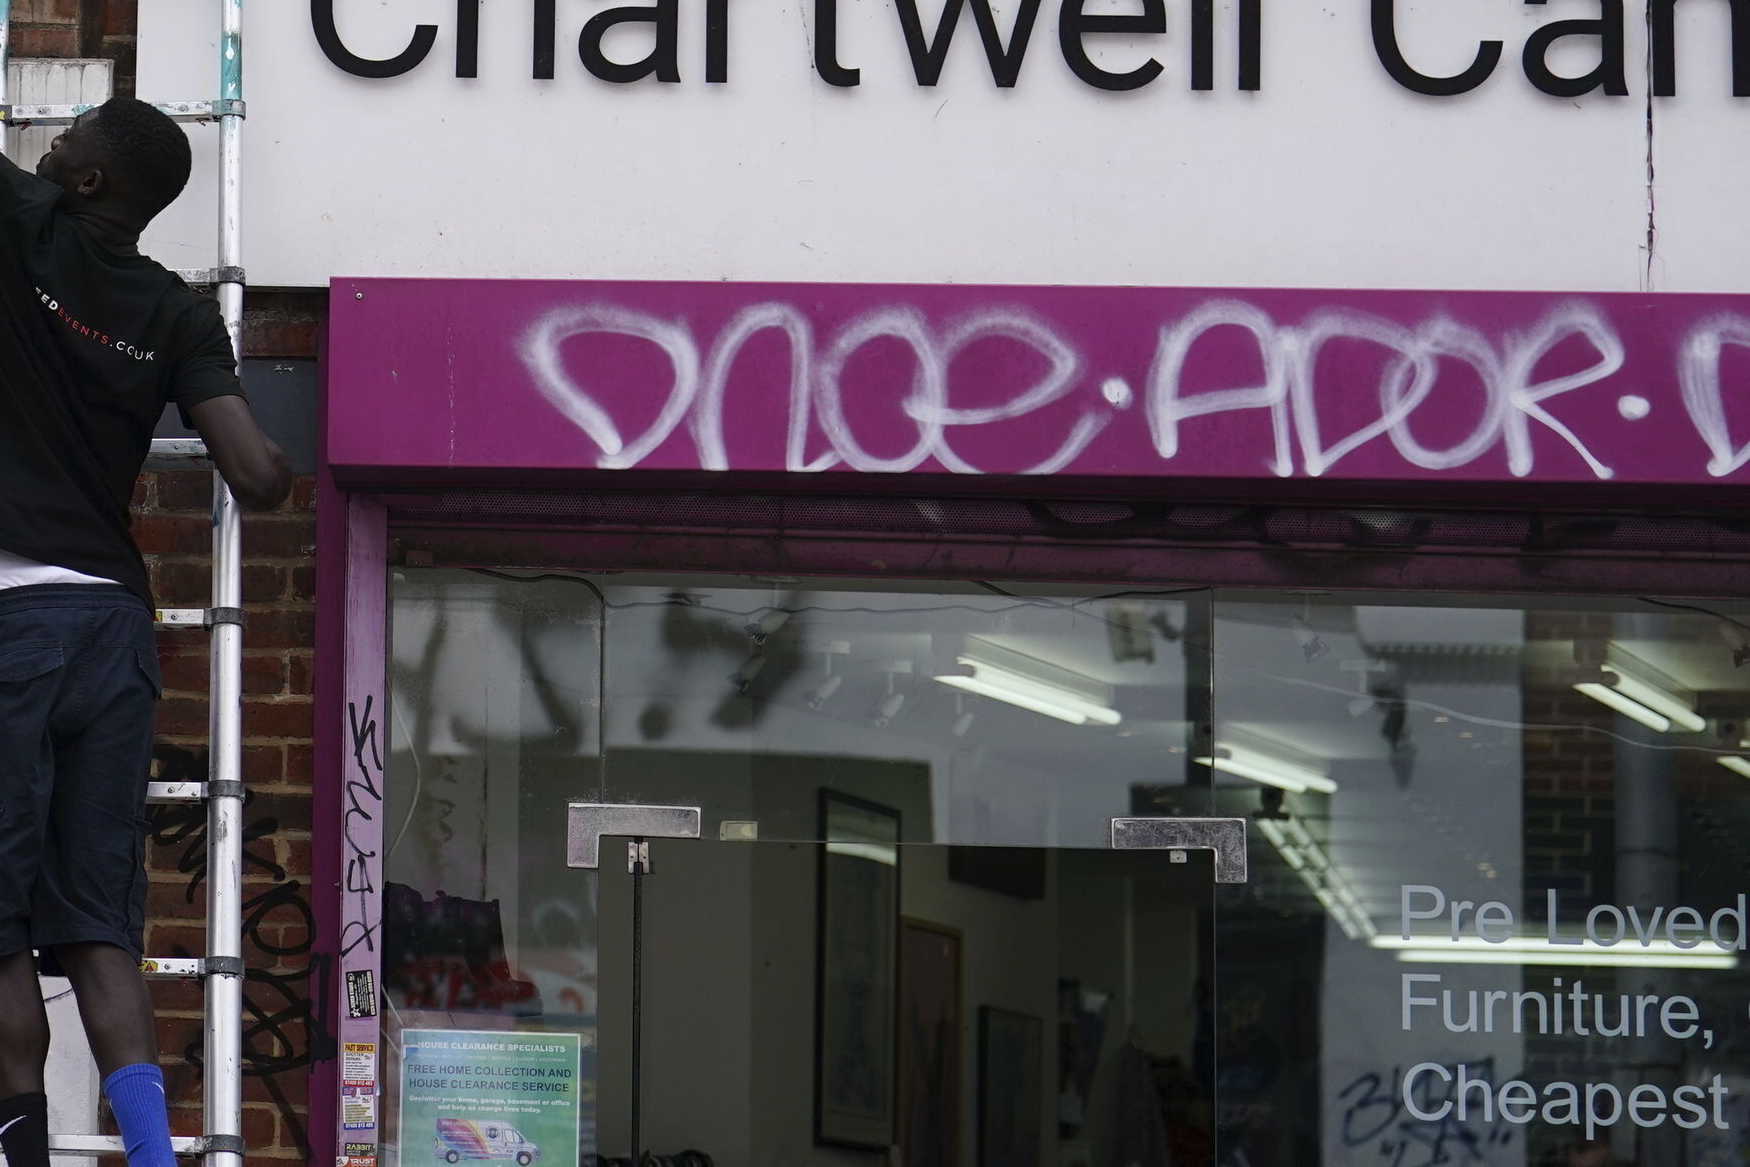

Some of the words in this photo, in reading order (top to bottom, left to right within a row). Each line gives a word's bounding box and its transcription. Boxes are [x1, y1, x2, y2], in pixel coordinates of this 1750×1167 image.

[1401, 884, 1514, 943] Pre
[1547, 888, 1747, 951] Loved
[1401, 973, 1713, 1050] Furniture,
[418, 1041, 449, 1049] HOUSE
[451, 1042, 505, 1051] CLEARANCE
[507, 1044, 566, 1053] SPECIALISTS
[407, 1064, 436, 1074] FREE
[439, 1065, 472, 1075] HOME
[475, 1066, 546, 1077] COLLECTION
[548, 1068, 572, 1078] AND
[409, 1078, 448, 1089] HOUSE
[450, 1080, 519, 1091] CLEARANCE
[522, 1081, 569, 1092] SERVICE
[1402, 1061, 1730, 1141] Cheapest
